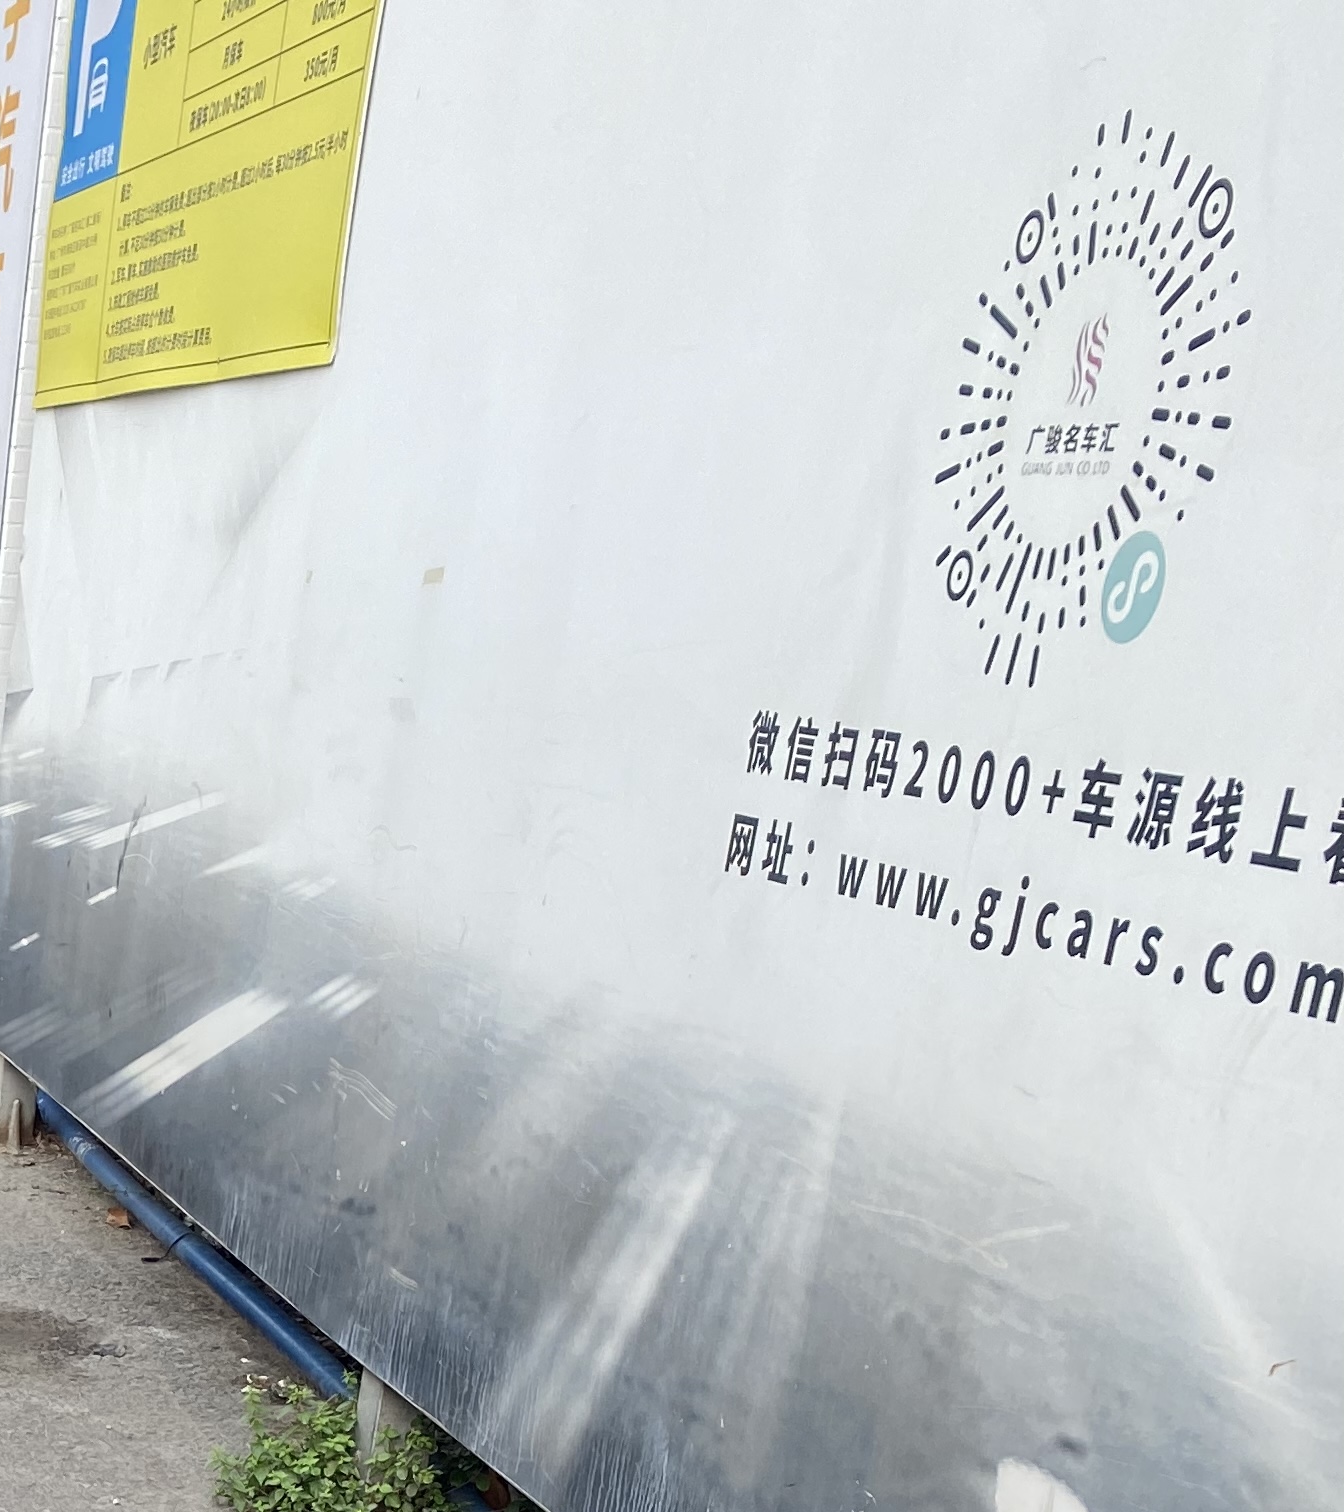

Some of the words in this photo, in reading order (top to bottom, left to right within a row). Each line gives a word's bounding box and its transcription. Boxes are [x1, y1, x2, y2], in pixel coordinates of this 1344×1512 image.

[143, 24, 178, 69] 小型汽车
[304, 45, 339, 82] 350元/月
[1025, 423, 1120, 454] 广骏名车汇
